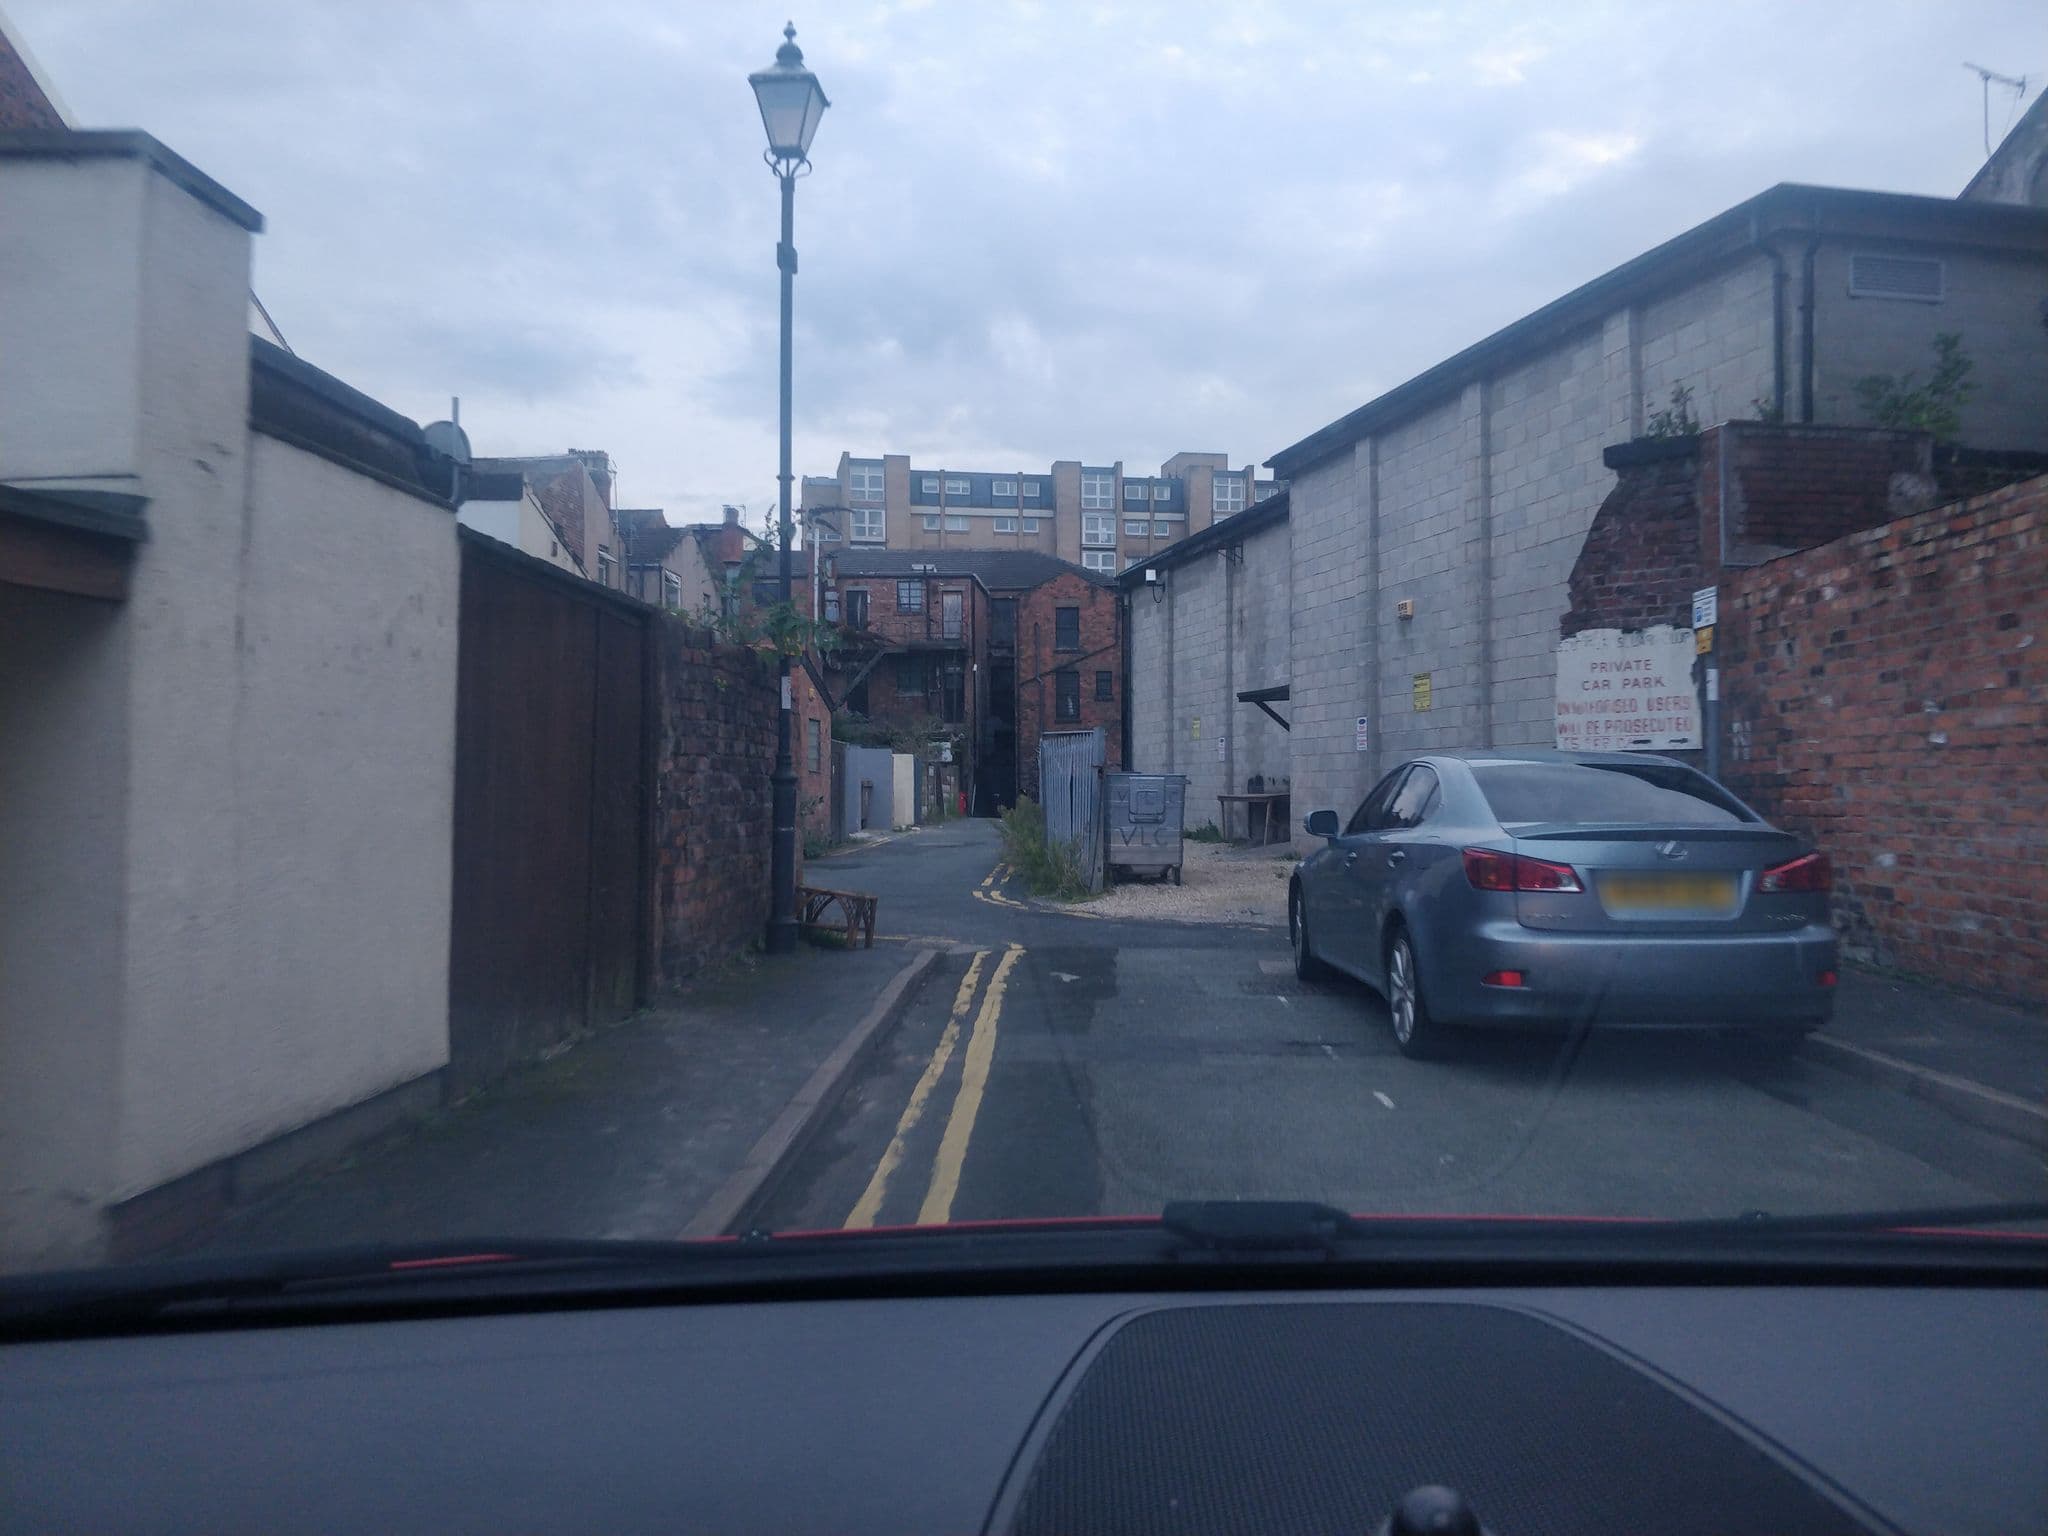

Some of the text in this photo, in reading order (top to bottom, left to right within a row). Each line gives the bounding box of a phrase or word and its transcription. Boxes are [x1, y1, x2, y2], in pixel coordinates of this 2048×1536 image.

[1590, 658, 1652, 673] PRIVATE
[1582, 676, 1665, 691] CAR PARK
